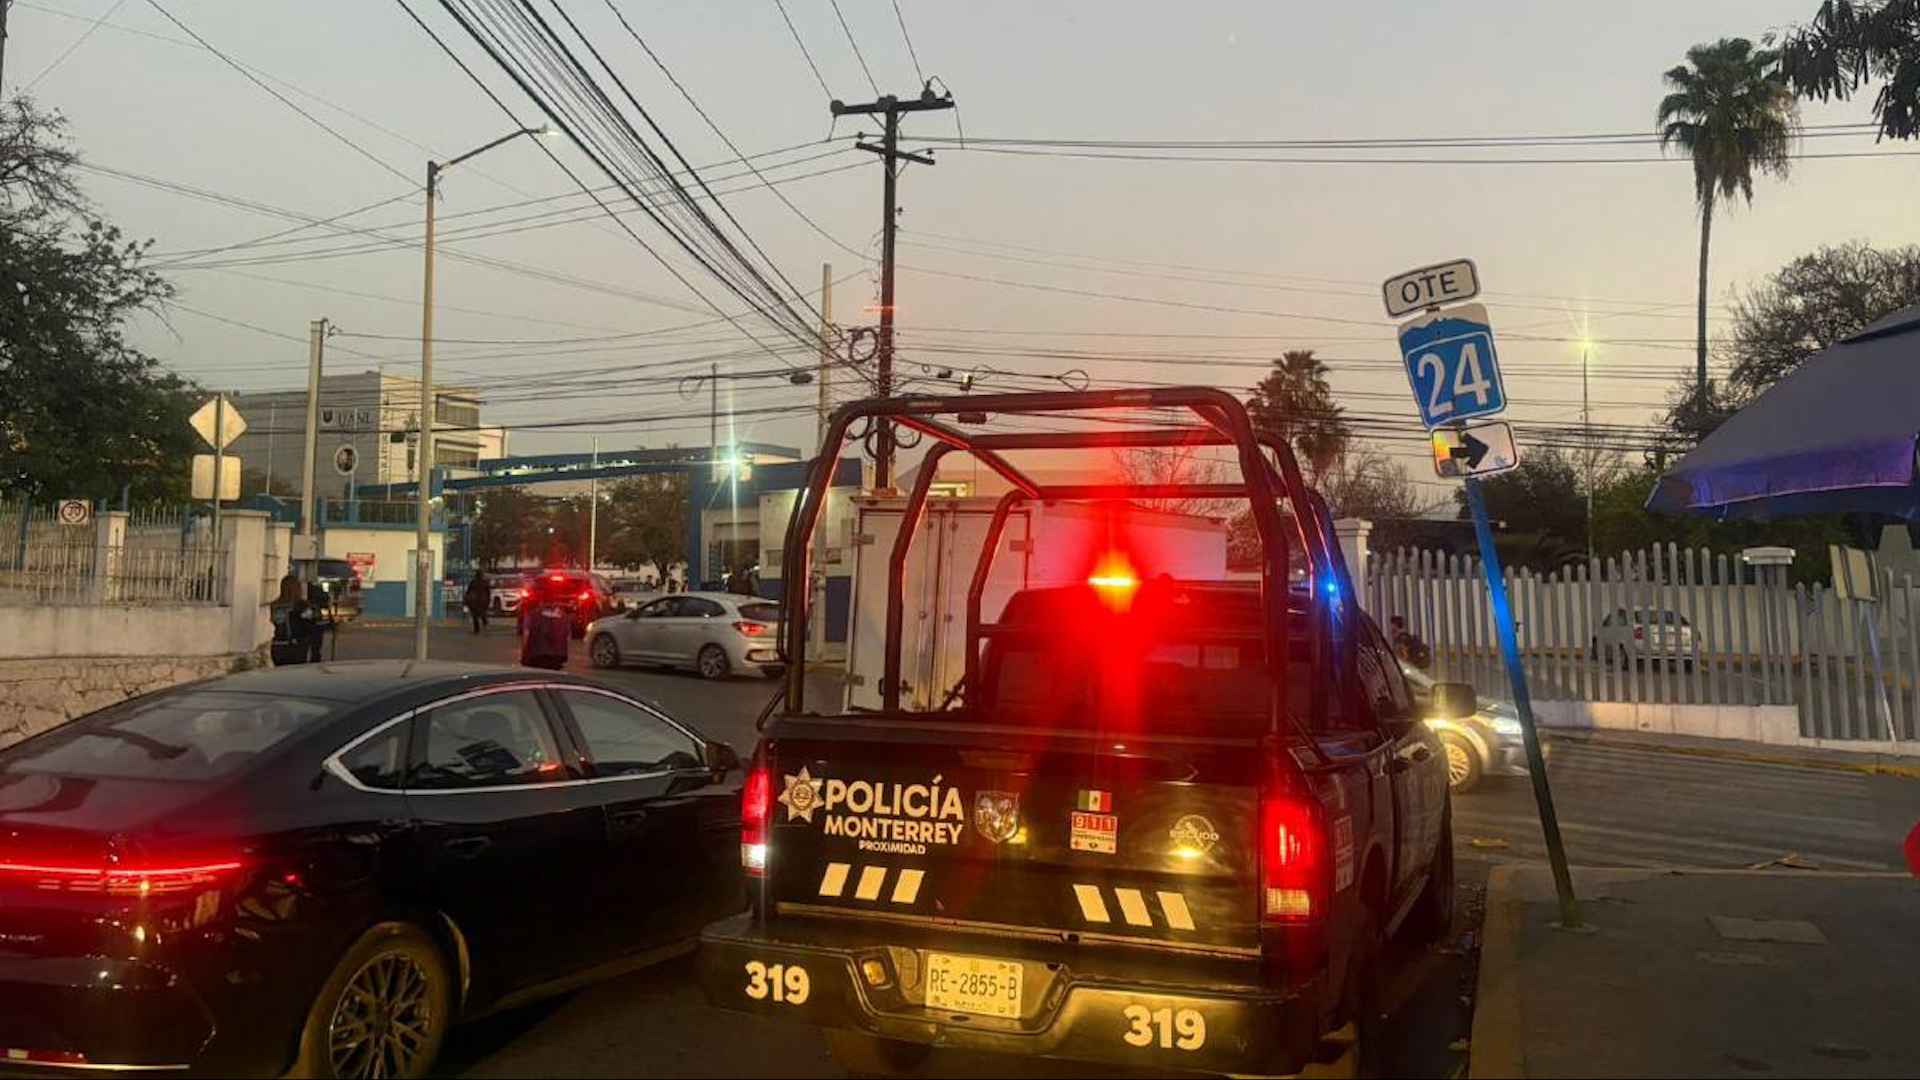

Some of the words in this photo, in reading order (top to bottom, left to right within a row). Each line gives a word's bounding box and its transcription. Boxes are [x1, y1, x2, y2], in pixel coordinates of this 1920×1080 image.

[1402, 271, 1459, 304] OTE
[1417, 342, 1490, 417] 24
[825, 774, 965, 820] POLICÍA
[824, 814, 964, 845] MONTERREY
[1075, 816, 1113, 832] 911
[858, 839, 927, 855] PROXIMIDAD
[744, 960, 810, 1006] 319
[930, 968, 1017, 1000] RE-2855-B
[1124, 1004, 1206, 1051] 319
